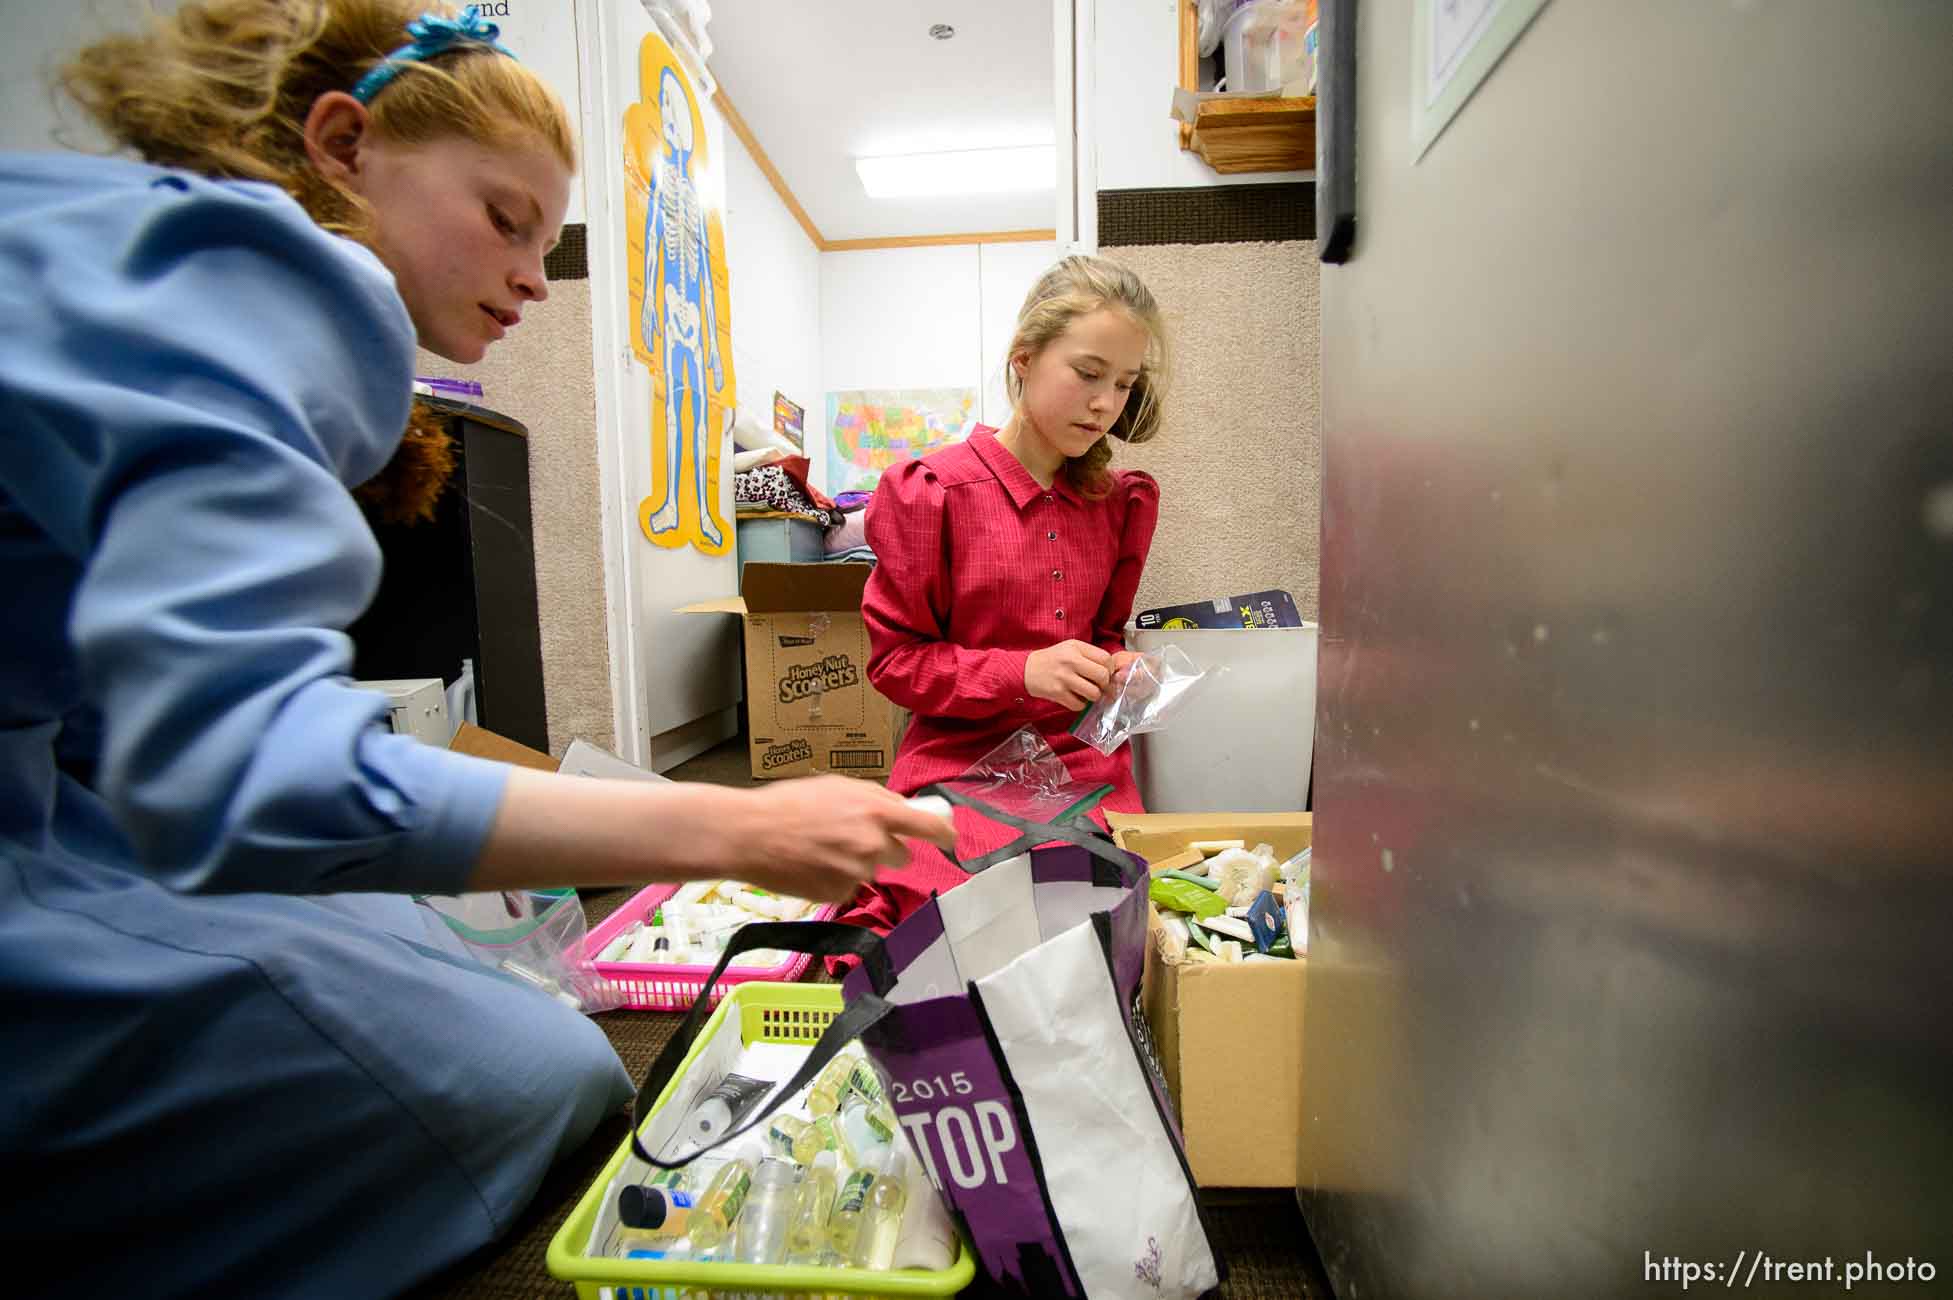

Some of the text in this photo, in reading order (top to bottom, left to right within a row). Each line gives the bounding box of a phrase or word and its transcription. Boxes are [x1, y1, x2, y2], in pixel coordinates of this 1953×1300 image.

[469, 0, 510, 17] nd
[1140, 614, 1156, 628] 10
[790, 656, 848, 681] Honey Nut
[780, 666, 857, 702] Scooters
[763, 746, 811, 768] Scooters
[892, 1071, 973, 1103] 2015
[899, 1101, 1017, 1191] TOP
